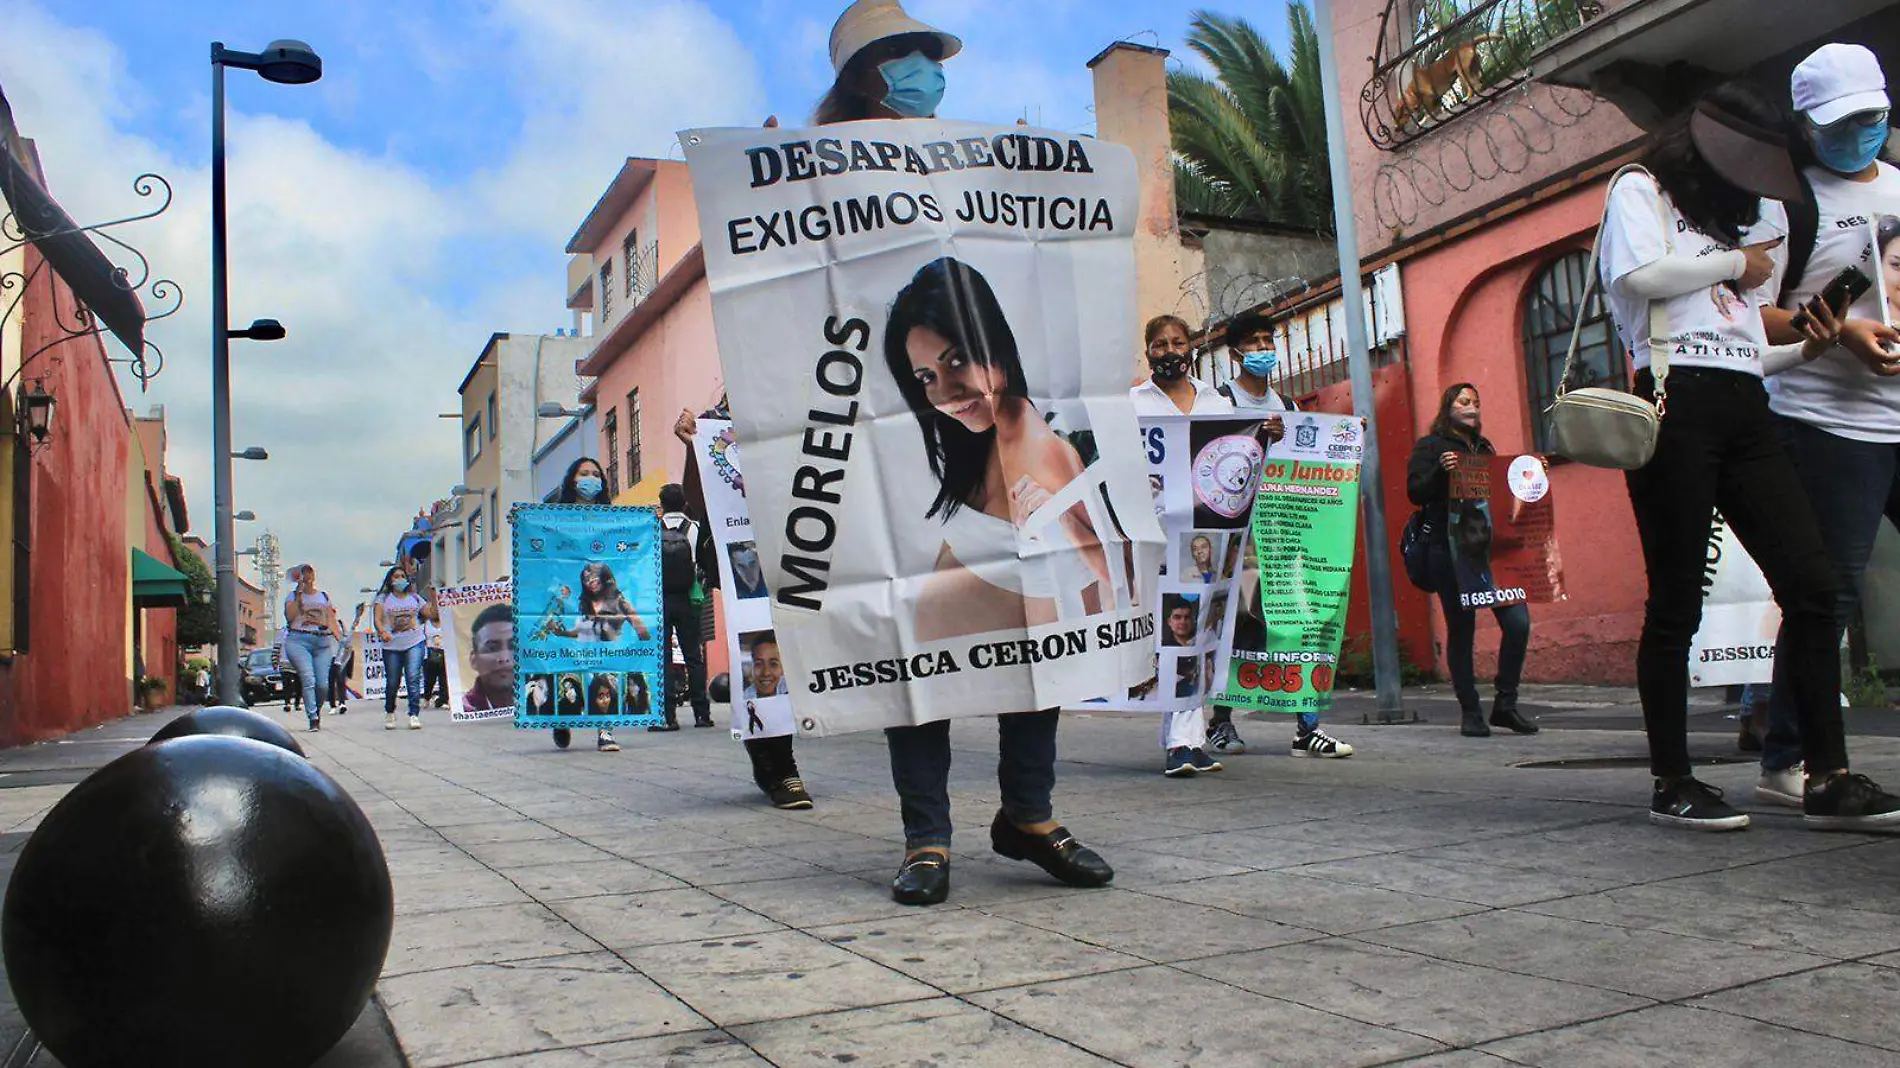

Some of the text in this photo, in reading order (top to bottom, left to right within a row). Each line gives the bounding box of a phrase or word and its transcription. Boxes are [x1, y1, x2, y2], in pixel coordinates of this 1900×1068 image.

[744, 132, 1094, 189] DESAPARECIDA
[727, 190, 1114, 255] EXIGIMOS JUSTICIA
[1835, 215, 1870, 229] DES
[1675, 344, 1687, 355] A
[1693, 344, 1708, 356] TI
[777, 314, 871, 612] MORELOS
[1284, 484, 1338, 496] HERNANDEZ
[1471, 591, 1495, 606] 685
[1496, 587, 1527, 602] 0010
[523, 647, 655, 661] Mireya Montiel Hernández
[808, 612, 1155, 693] JESSICA CERON SALINAS
[1237, 661, 1303, 693] 685
[1257, 694, 1297, 707] #Oaxaca
